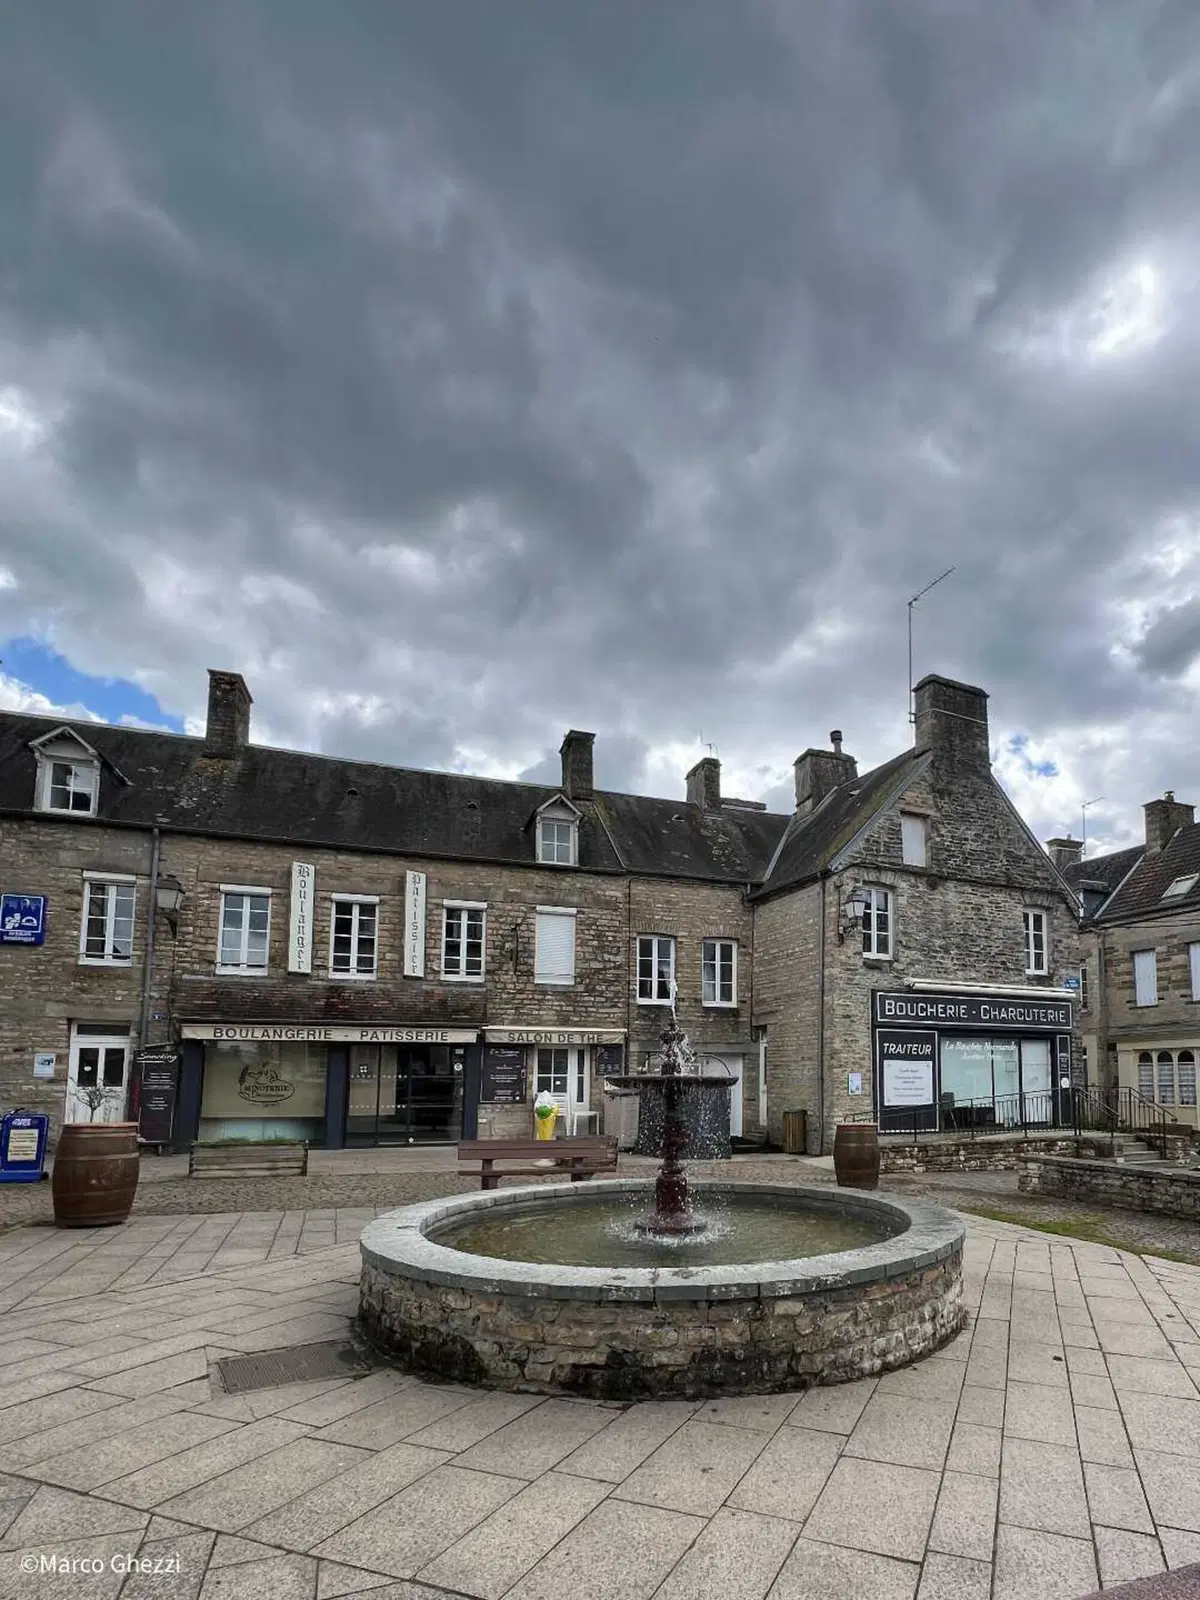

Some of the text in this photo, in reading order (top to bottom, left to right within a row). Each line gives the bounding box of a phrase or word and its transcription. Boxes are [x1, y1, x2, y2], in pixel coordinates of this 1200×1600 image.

[213, 1027, 333, 1040] BOULANGERIE
[360, 1030, 448, 1041] PATISSERIE
[508, 1032, 552, 1042] SALON
[557, 1033, 574, 1043] DE
[883, 1043, 932, 1055] TRAITEUR
